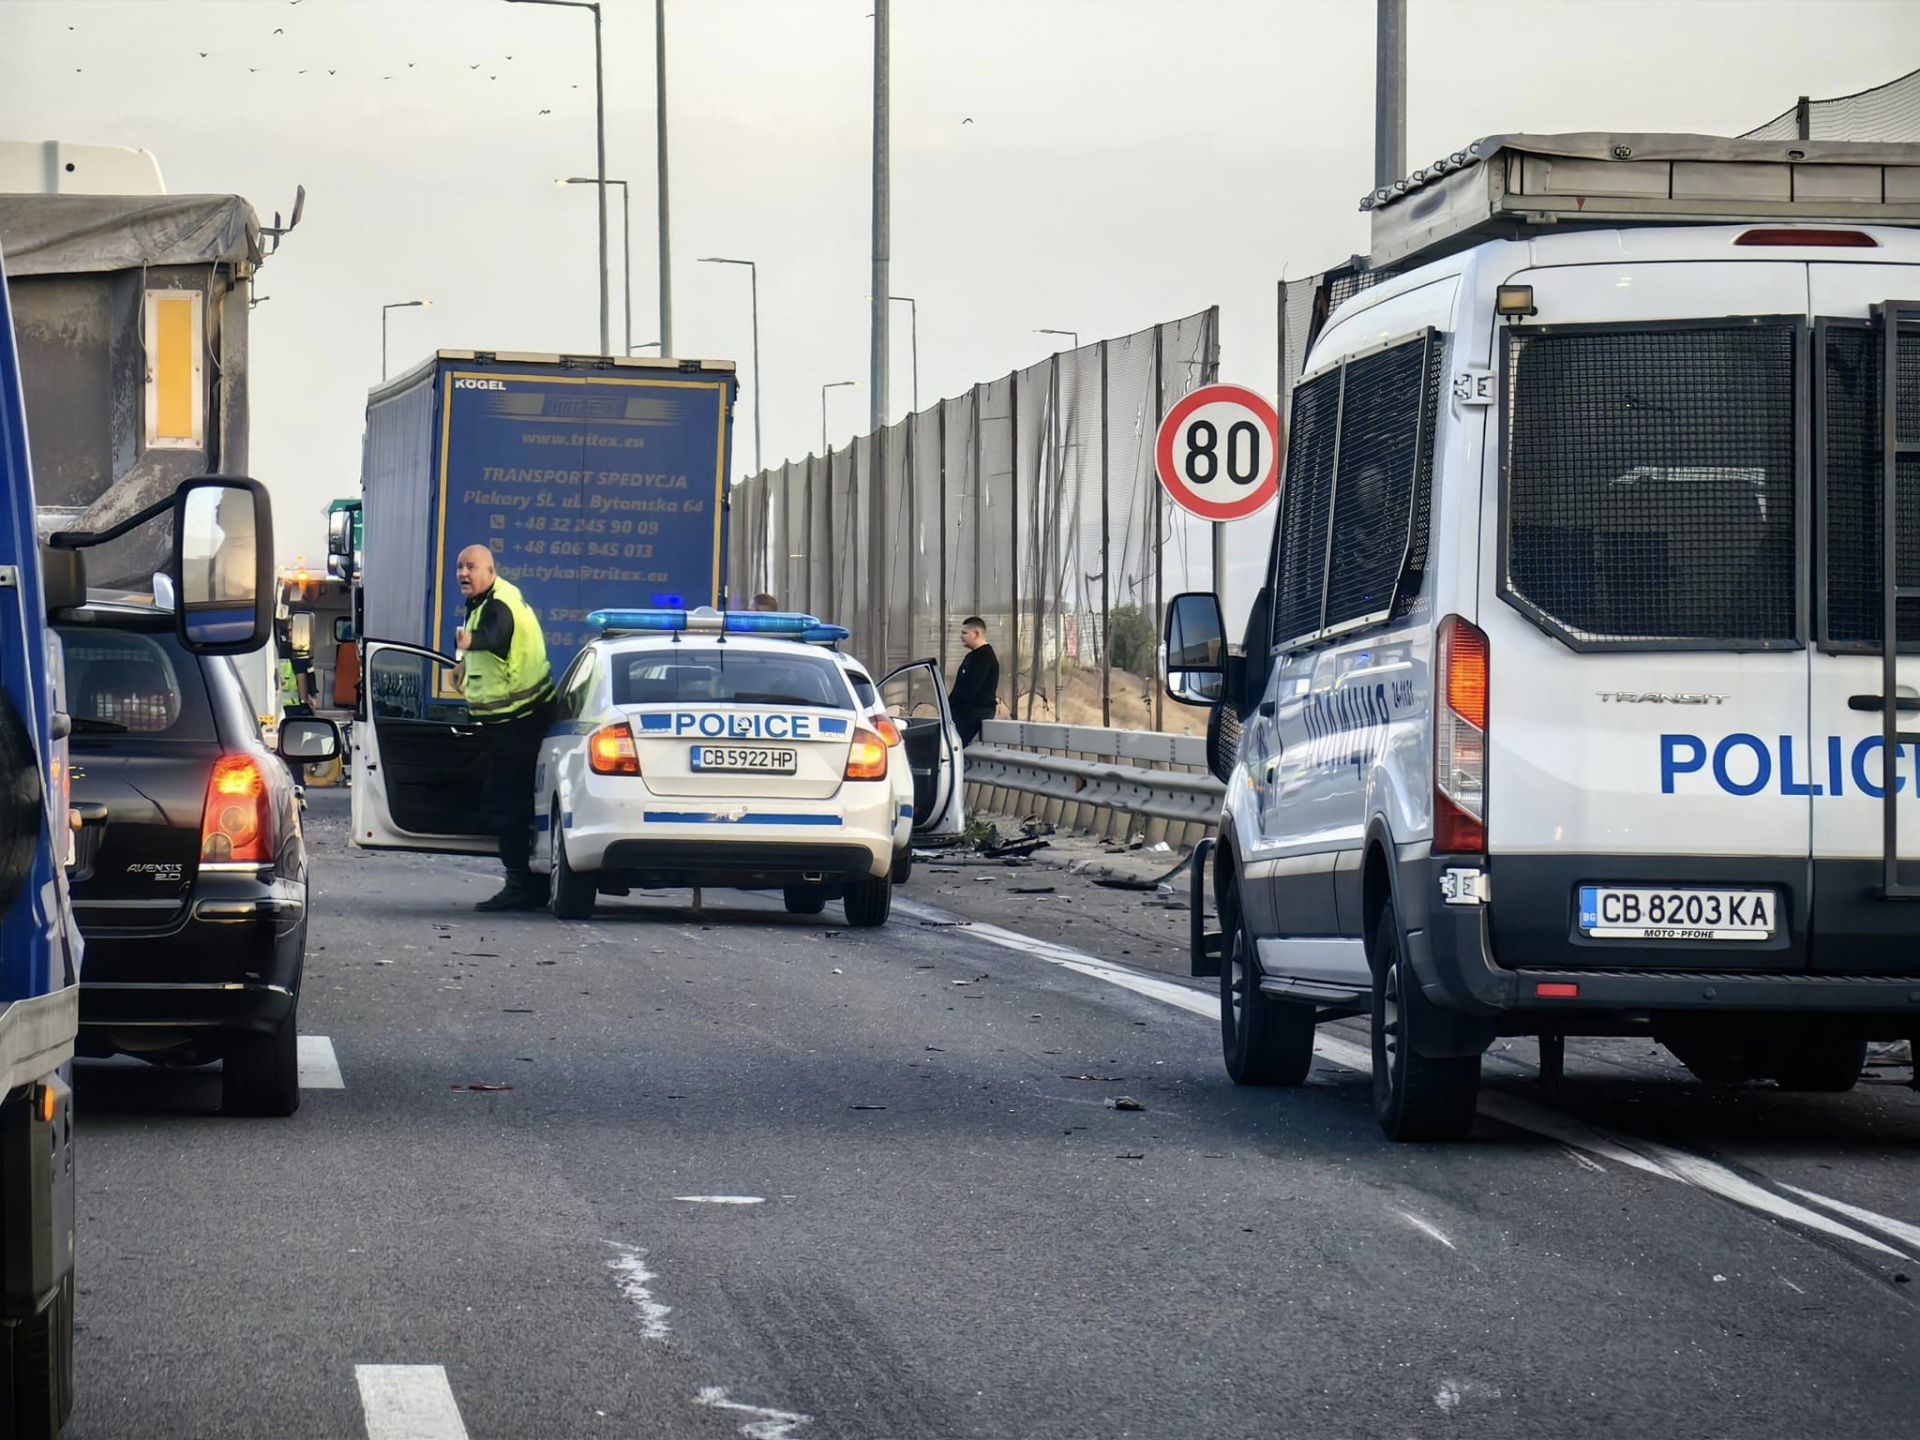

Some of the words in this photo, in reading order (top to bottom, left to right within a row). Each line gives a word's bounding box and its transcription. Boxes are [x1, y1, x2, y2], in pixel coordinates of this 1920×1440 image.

[522, 432, 645, 449] www.tritex.eu
[1186, 420, 1259, 485] 80
[483, 467, 593, 486] TRANSPORT
[597, 472, 688, 489] SPEDYCJA
[463, 490, 532, 509] Piekary
[590, 495, 678, 514] Bytomska
[683, 500, 704, 513] 64
[513, 519, 547, 531] +48
[550, 520, 570, 532] 32
[573, 520, 605, 533] 245
[610, 521, 632, 534] 90
[512, 541, 547, 555] +48
[550, 541, 583, 556] 606
[588, 542, 618, 557] 945
[1596, 691, 1731, 705] TRANSIT
[675, 713, 811, 739] POLICE
[703, 749, 725, 766] CB
[728, 750, 768, 767] 5922
[771, 751, 793, 768] HP
[1660, 733, 1920, 799] POLIC
[126, 863, 182, 873] AVENSIS
[1582, 912, 1596, 922] BG
[1601, 893, 1641, 924] CB
[1648, 894, 1722, 925] 8203
[1729, 896, 1768, 926] KA
[1643, 929, 1714, 939] MOTO-PFOHE
